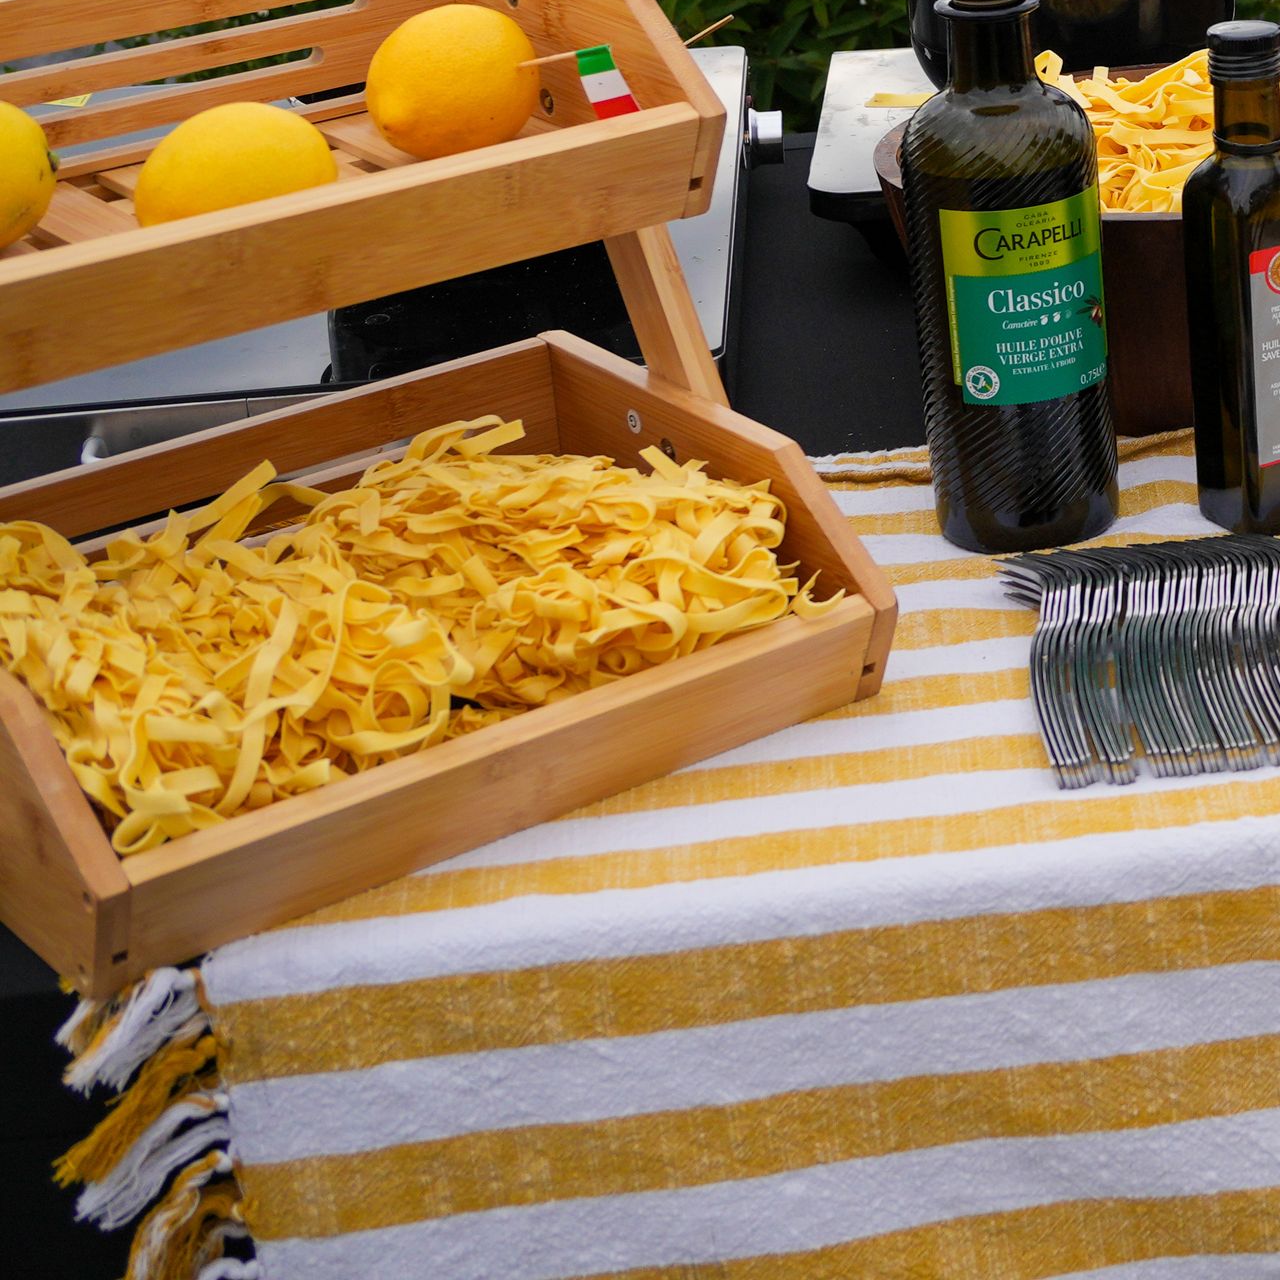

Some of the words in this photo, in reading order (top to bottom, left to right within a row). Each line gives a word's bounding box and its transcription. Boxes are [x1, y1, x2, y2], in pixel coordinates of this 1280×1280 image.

[973, 218, 1082, 260] CARAPELLI
[1019, 250, 1059, 262] FIRENZE
[987, 280, 1085, 314] Classico
[1002, 318, 1039, 330] Caractère
[996, 338, 1037, 354] HUILE
[1040, 327, 1083, 349] D'OLIVE
[1000, 351, 1046, 365] VIERGE
[1050, 340, 1084, 359] EXTRA
[1012, 364, 1049, 375] EXTRAITE
